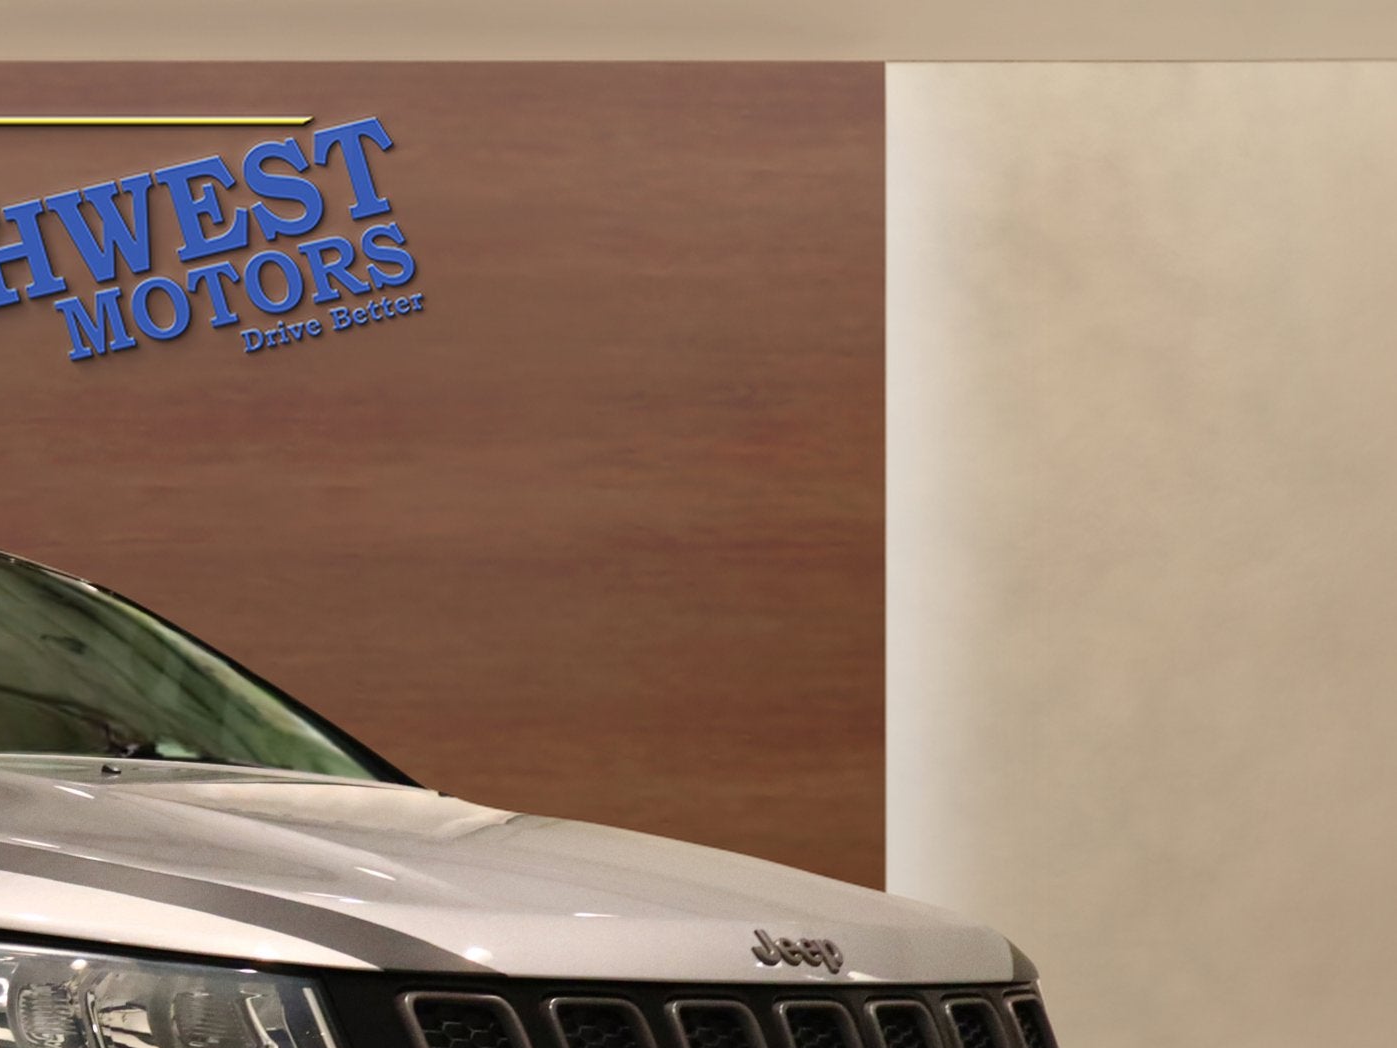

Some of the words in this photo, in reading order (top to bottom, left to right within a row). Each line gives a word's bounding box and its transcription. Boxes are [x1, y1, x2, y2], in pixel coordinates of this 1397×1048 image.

[55, 223, 416, 361] MOTORS
[241, 321, 321, 353] Drive
[331, 294, 424, 331] Better
[750, 928, 844, 975] Jeep
